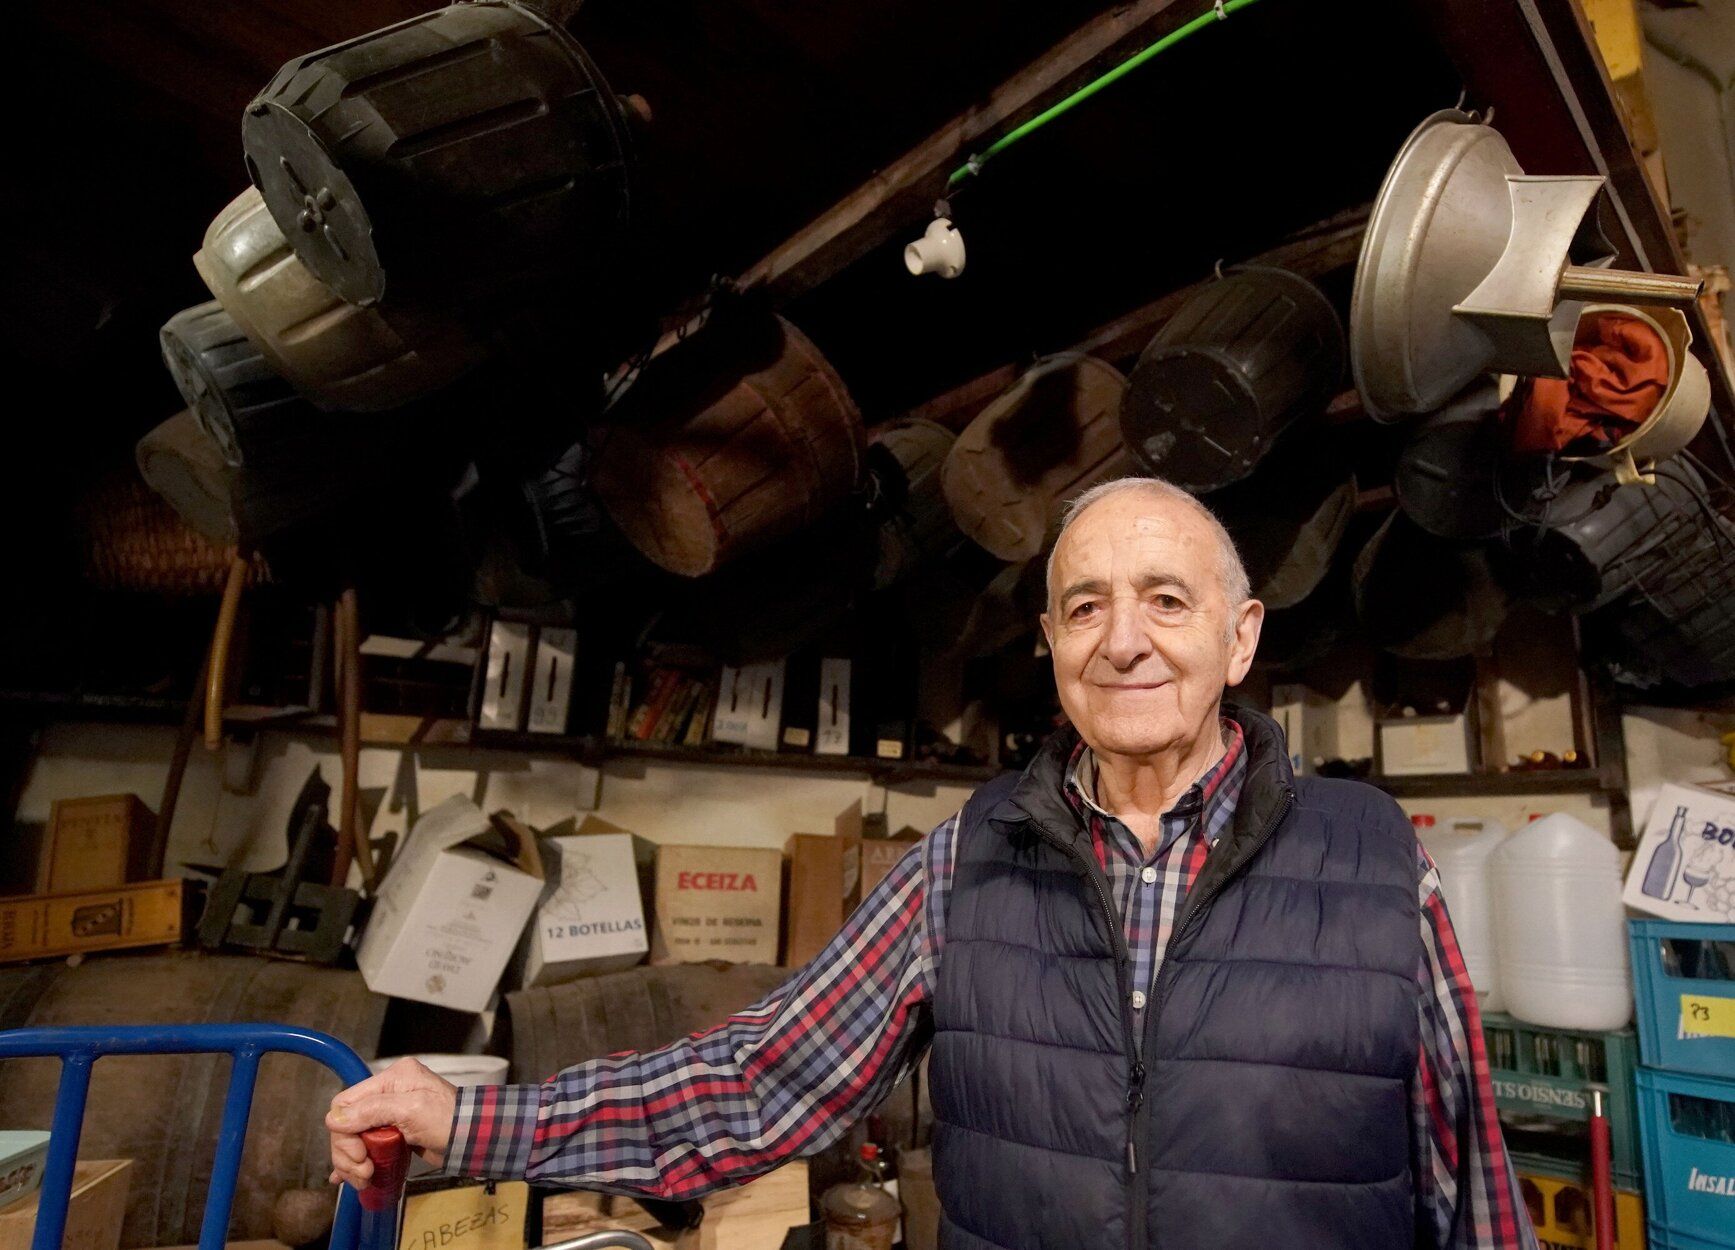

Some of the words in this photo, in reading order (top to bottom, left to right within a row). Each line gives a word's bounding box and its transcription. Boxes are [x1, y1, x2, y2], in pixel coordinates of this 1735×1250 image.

[1702, 822, 1735, 850] BO
[677, 872, 757, 891] ECEIZA
[547, 926, 564, 938] 12
[569, 919, 642, 937] BOTELLAS
